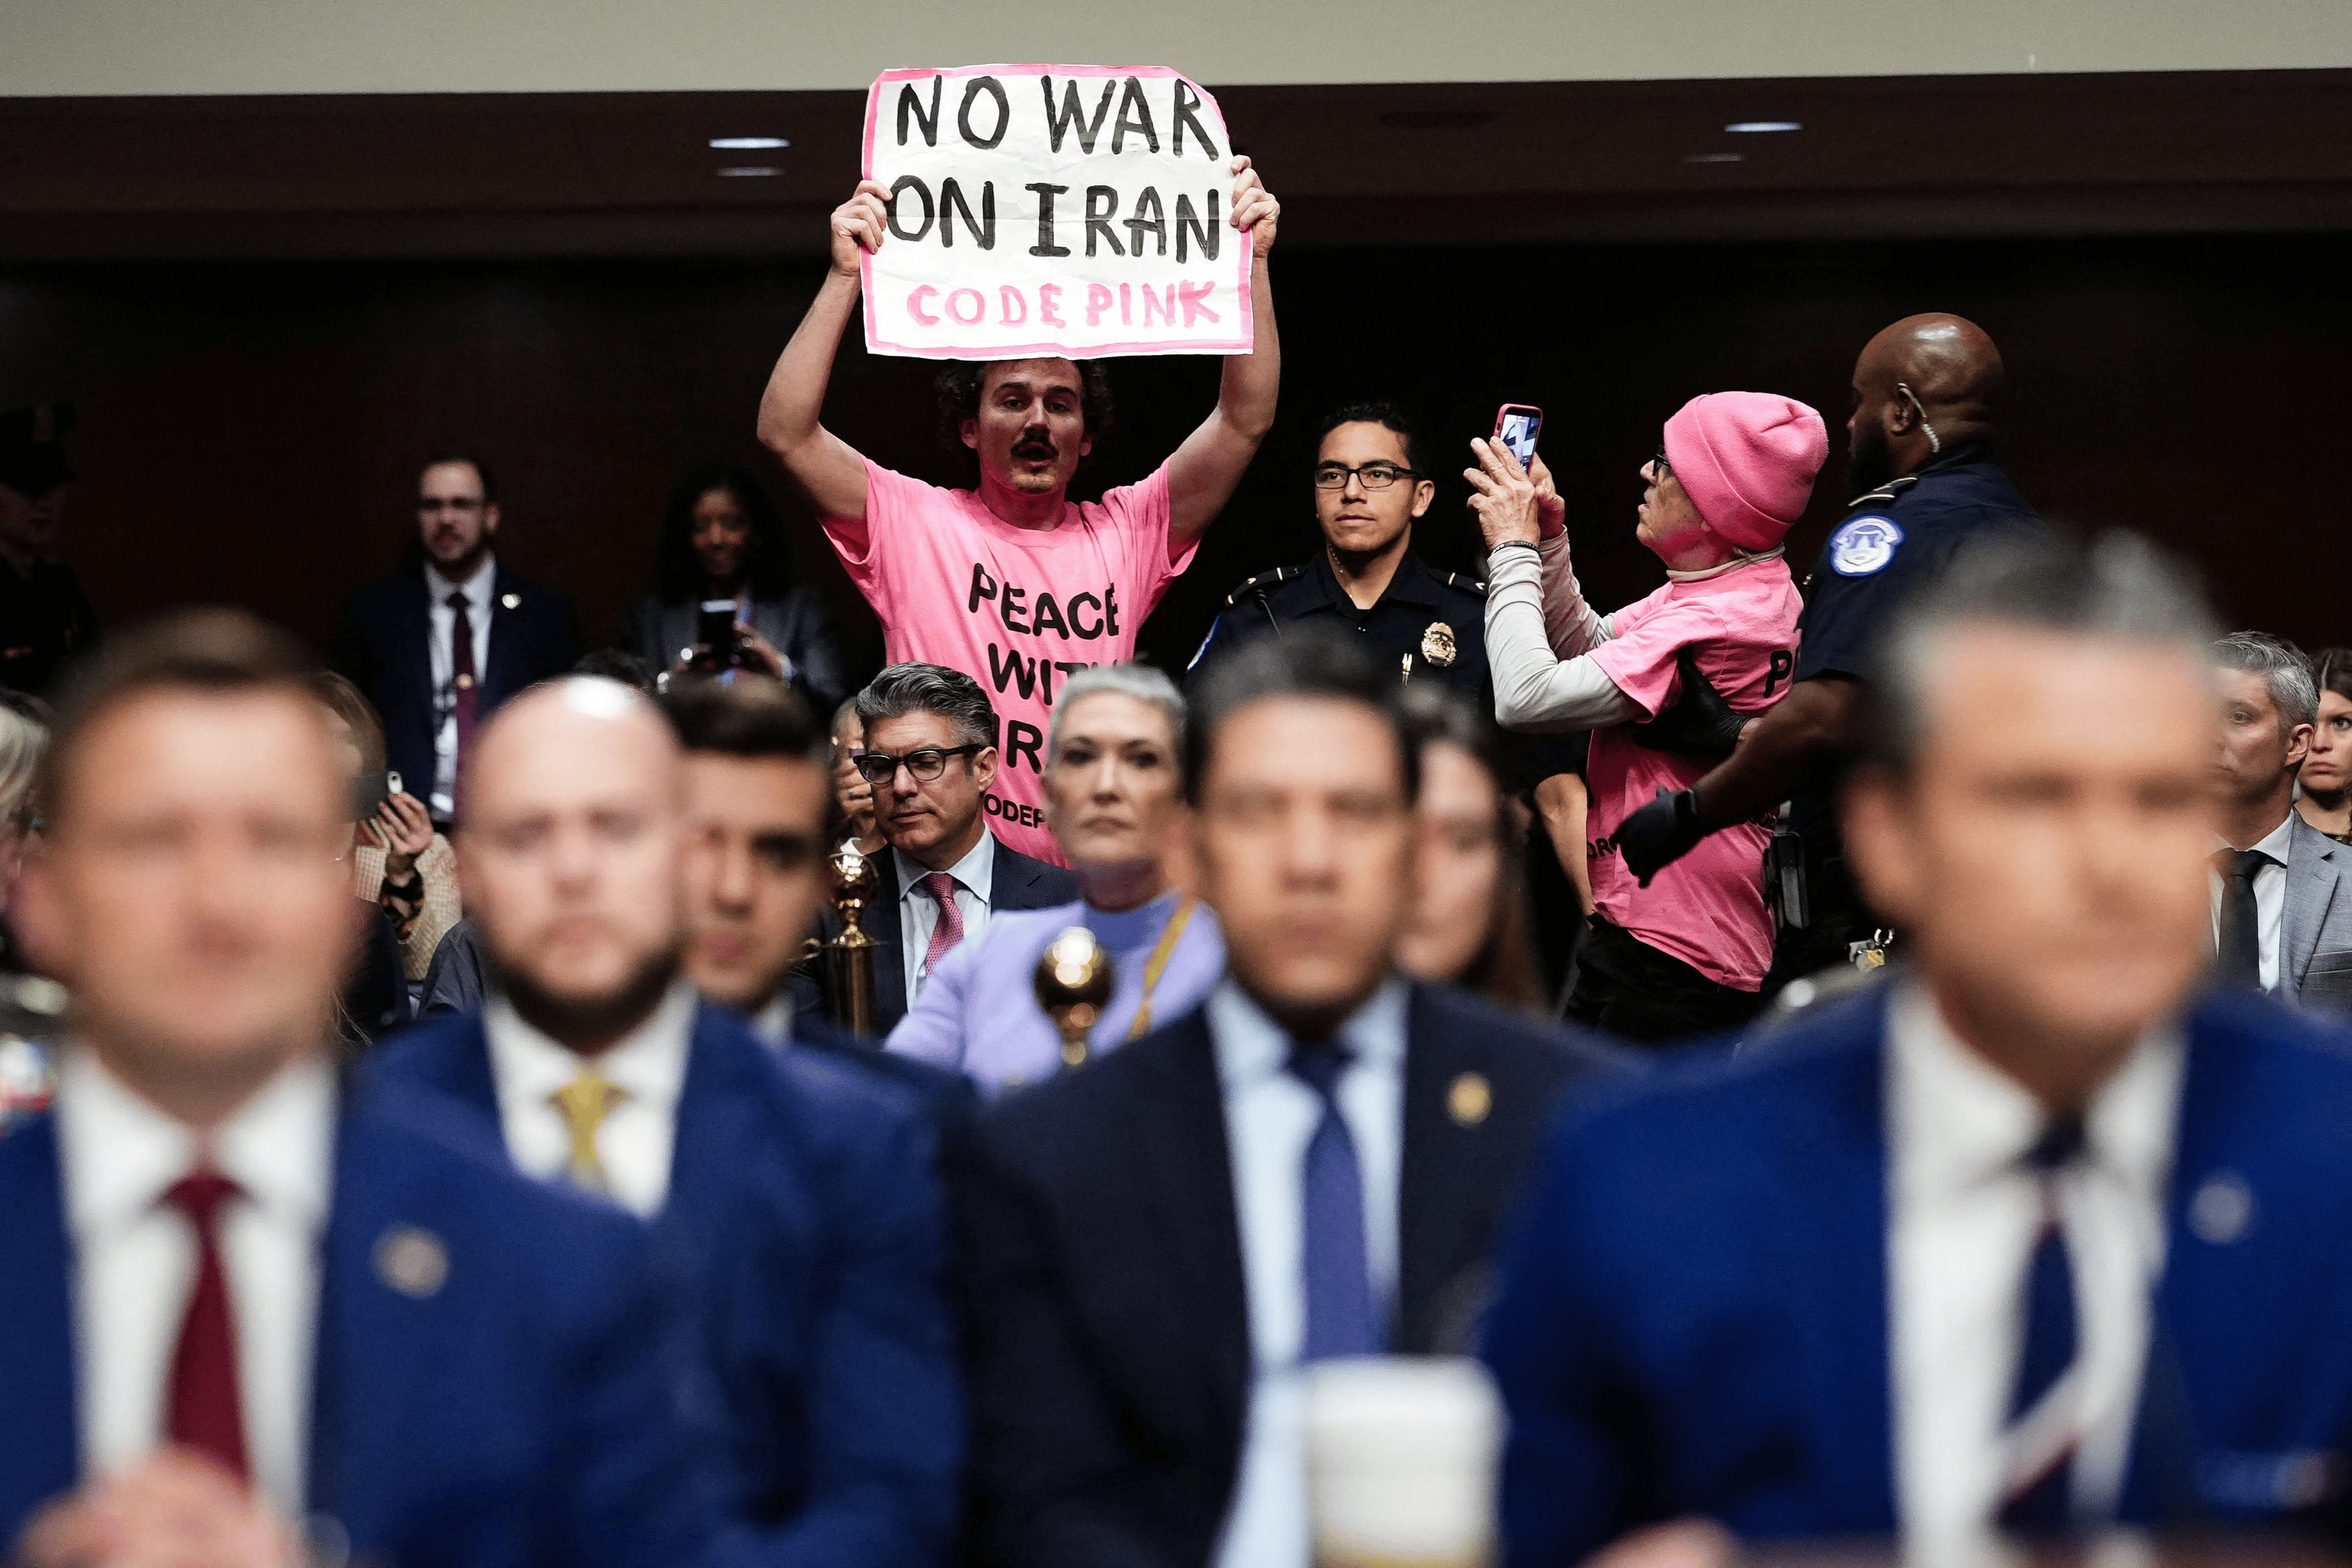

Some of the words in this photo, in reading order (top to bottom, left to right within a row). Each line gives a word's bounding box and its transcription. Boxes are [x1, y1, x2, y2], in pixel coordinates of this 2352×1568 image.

[896, 74, 1010, 149] NO
[1041, 75, 1220, 161] WAR
[886, 175, 995, 250] ON
[1025, 182, 1220, 264] IRAN
[907, 283, 1066, 329] CODE
[1085, 279, 1221, 329] PINK
[988, 642, 1118, 706] WIT
